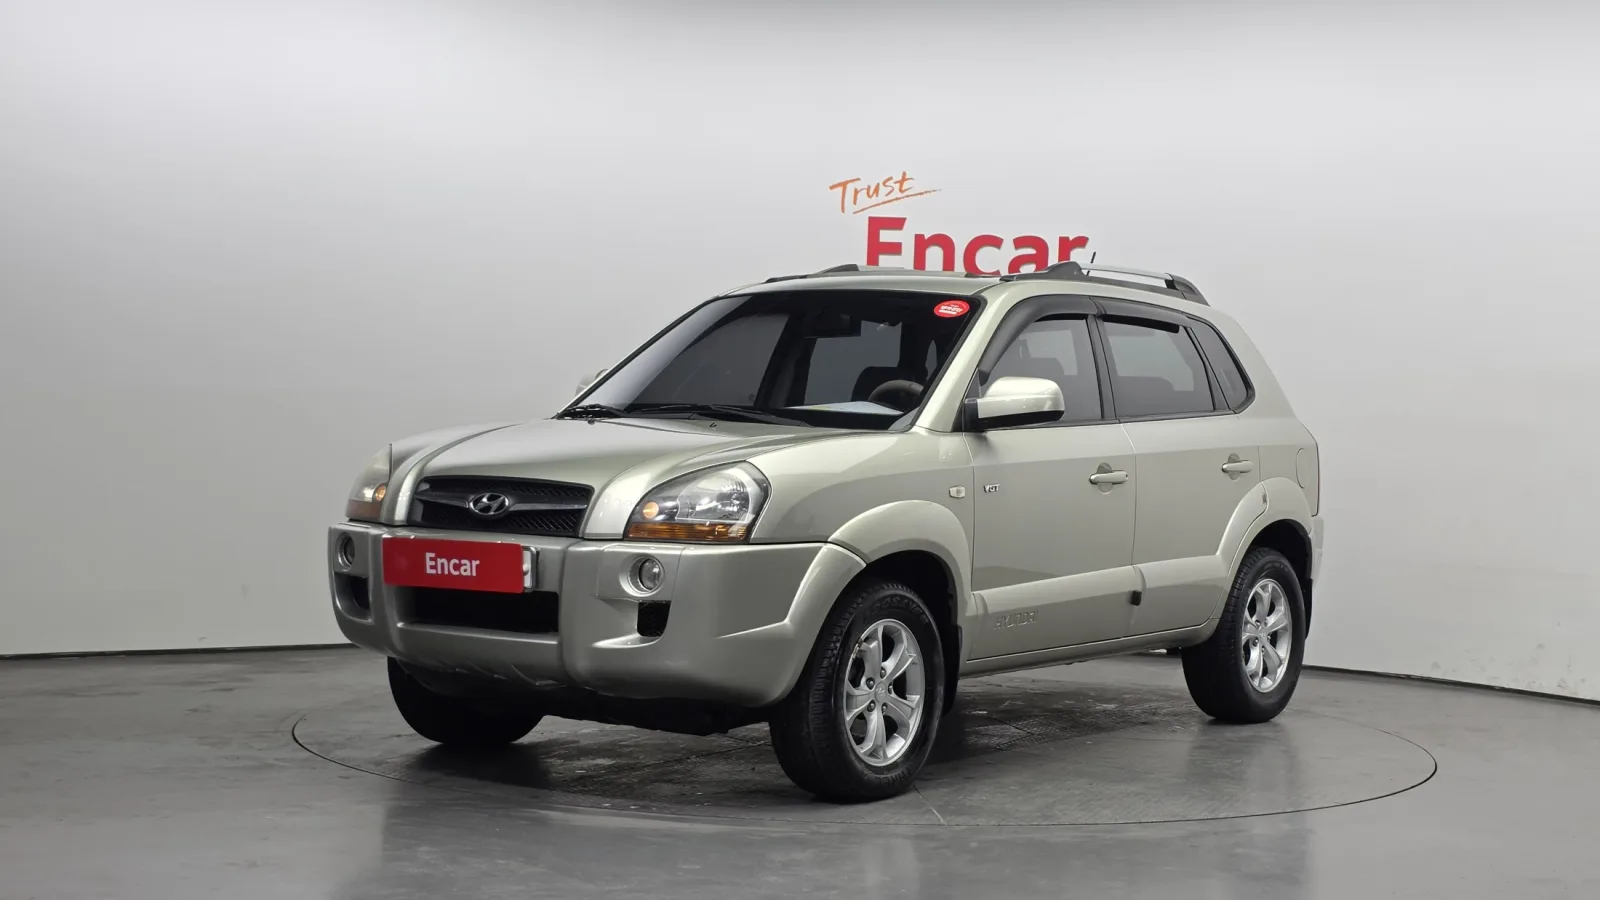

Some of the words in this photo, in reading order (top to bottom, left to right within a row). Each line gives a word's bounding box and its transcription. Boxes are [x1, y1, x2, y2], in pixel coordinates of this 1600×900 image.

[829, 171, 915, 214] Trust
[866, 216, 1090, 276] Encar
[425, 552, 480, 577] Encar
